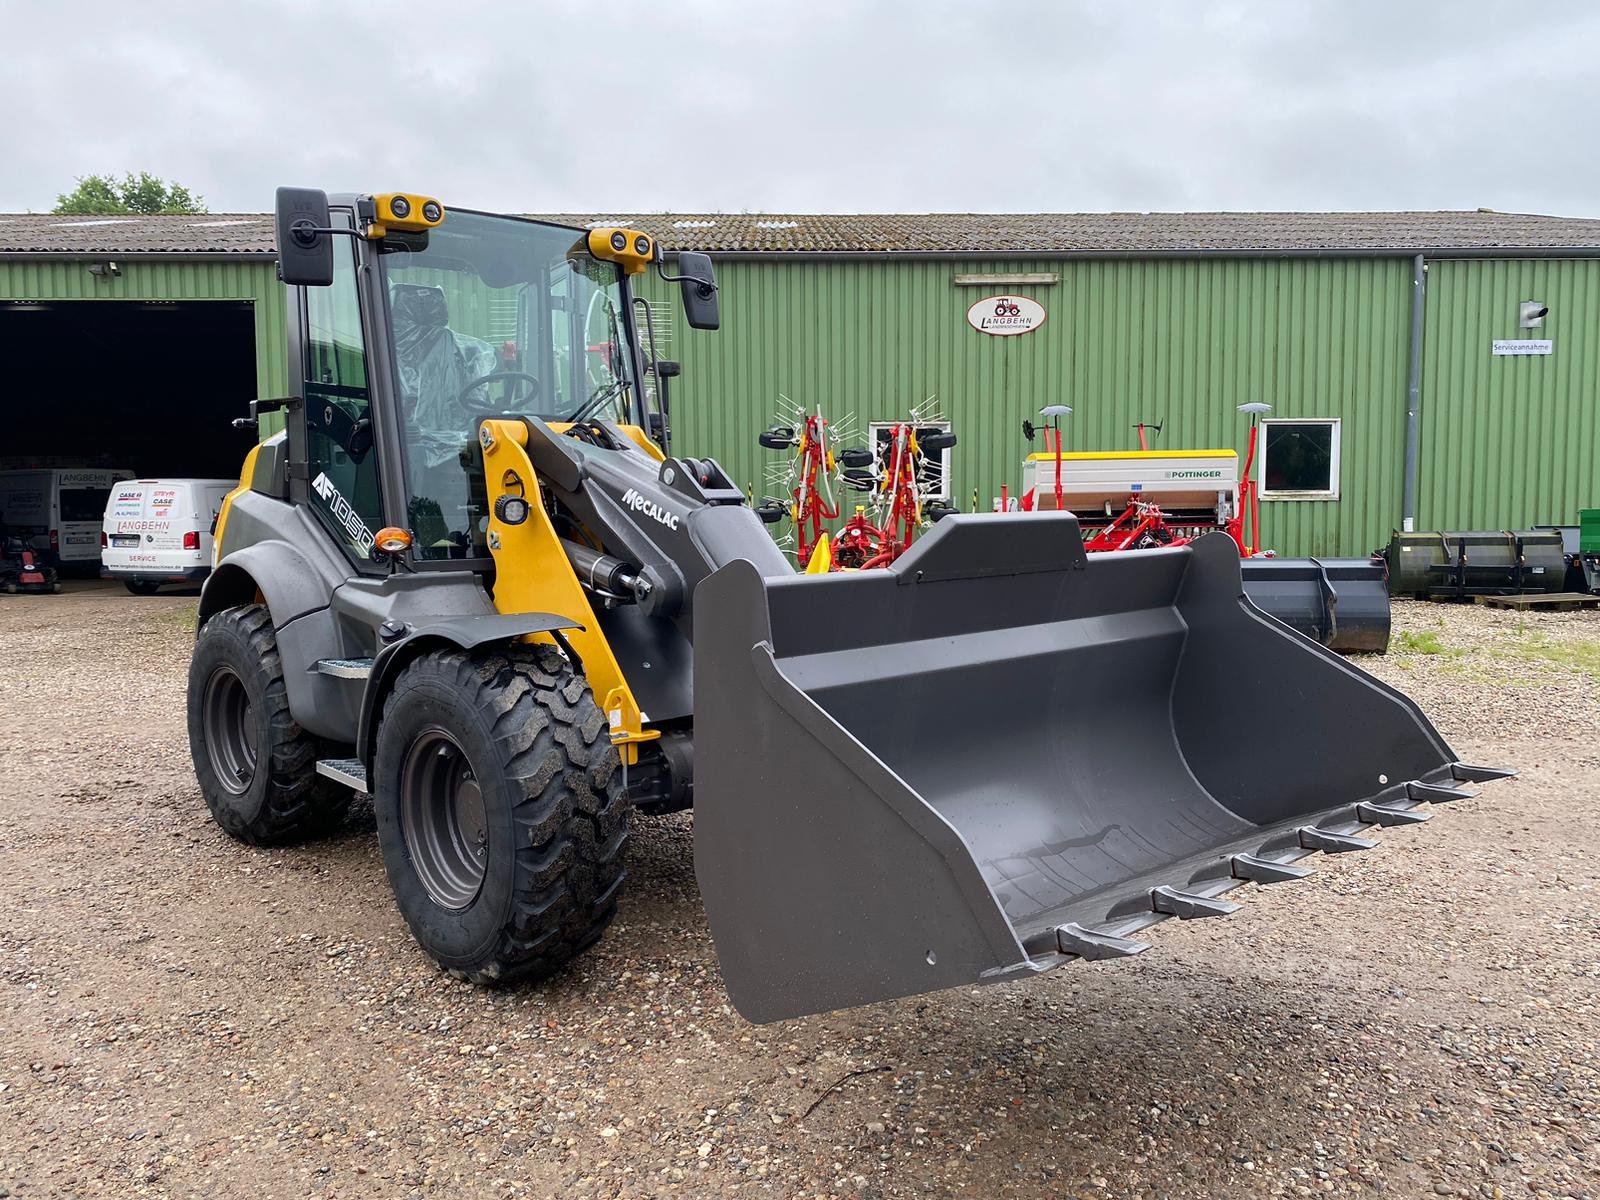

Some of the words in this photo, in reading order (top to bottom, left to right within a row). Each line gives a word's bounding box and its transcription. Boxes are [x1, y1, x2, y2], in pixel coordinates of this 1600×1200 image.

[981, 317, 1032, 329] LANGBEHN
[1494, 343, 1549, 351] Serviceannahme
[58, 473, 107, 486] LANGBEHN
[117, 521, 170, 533] LANGBEHN
